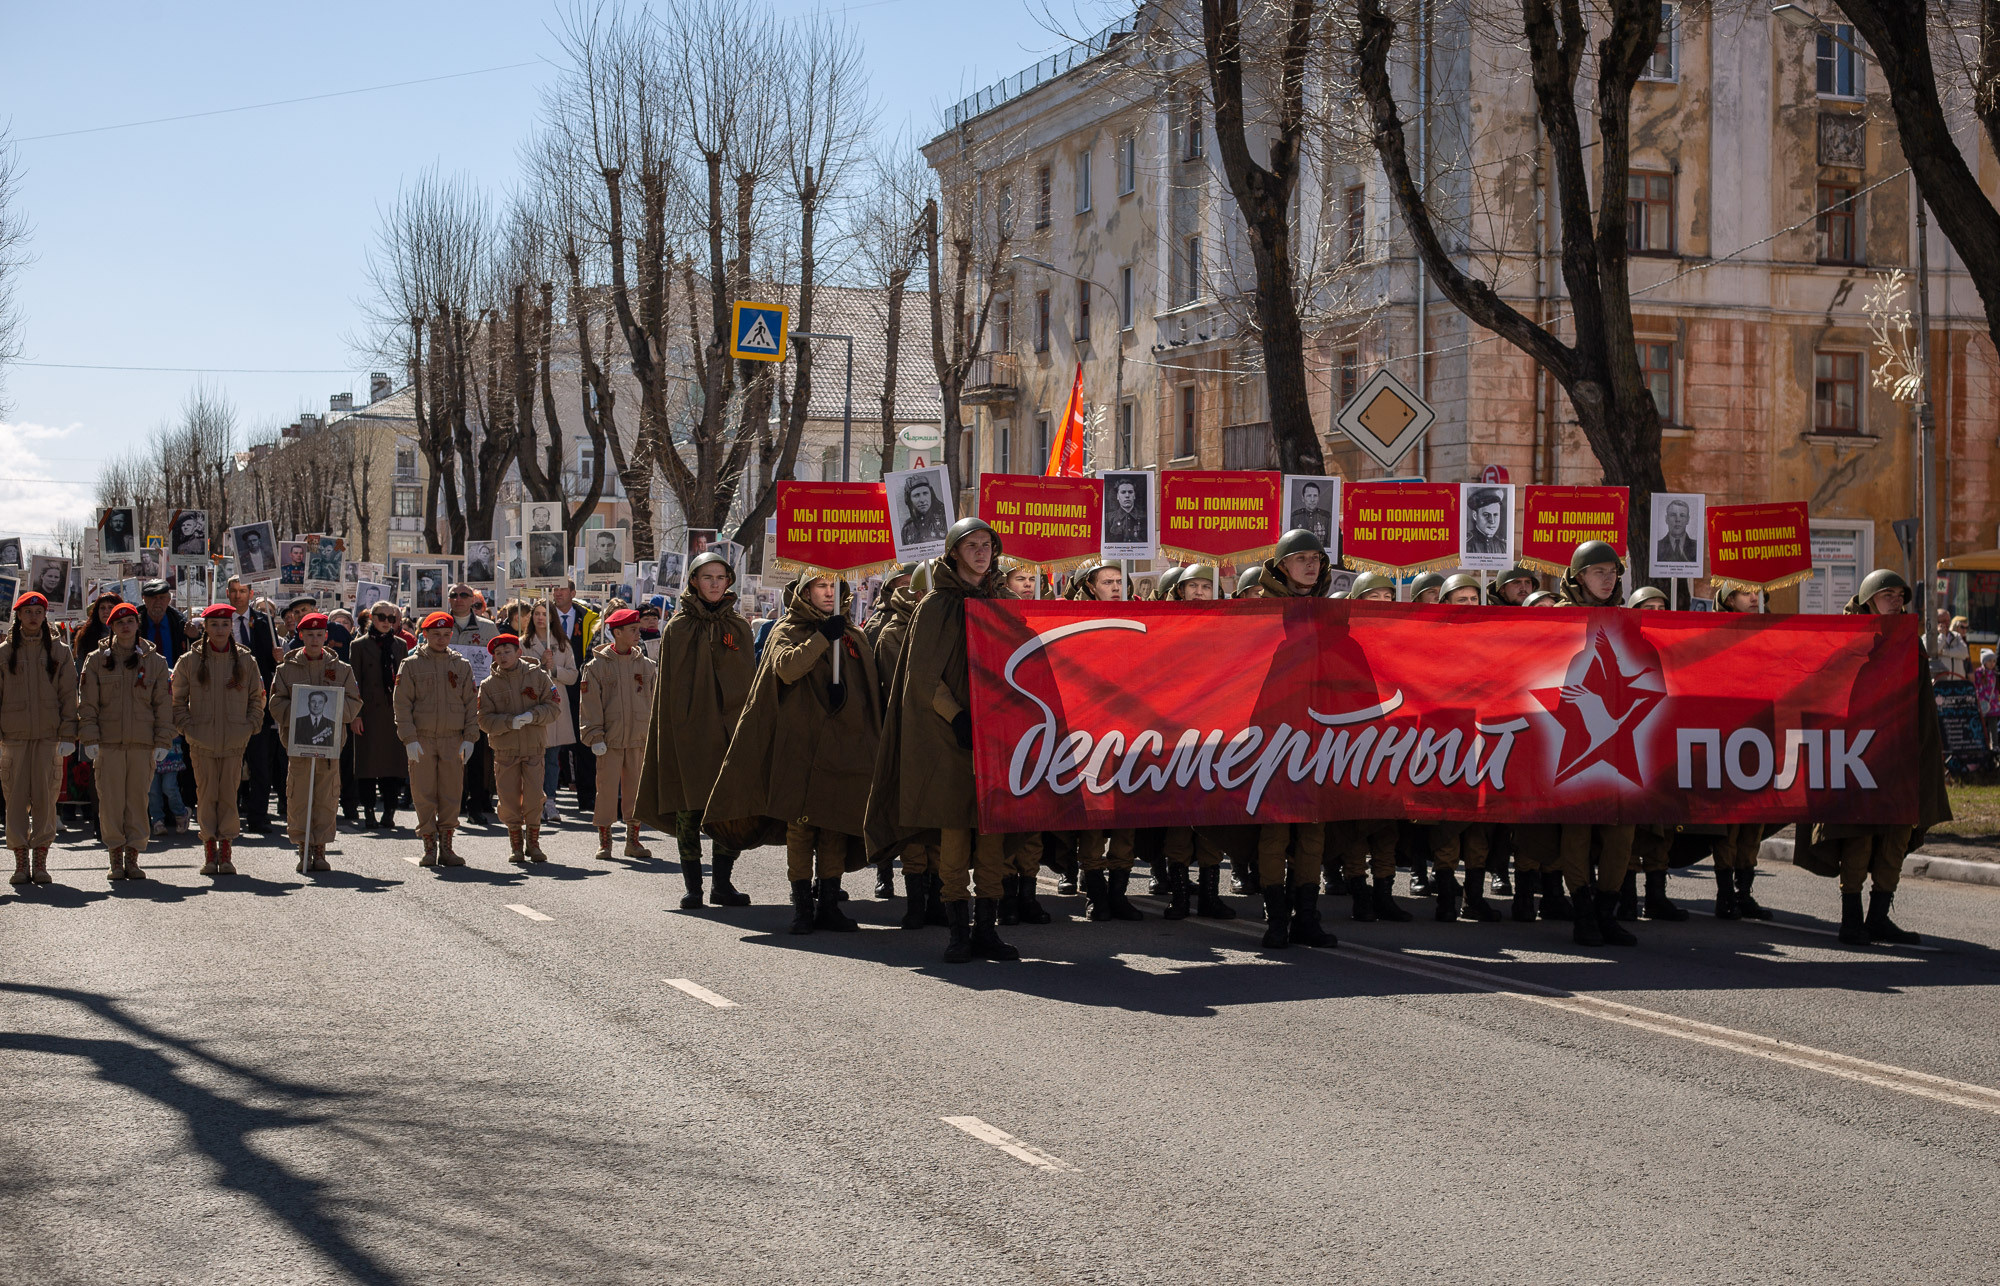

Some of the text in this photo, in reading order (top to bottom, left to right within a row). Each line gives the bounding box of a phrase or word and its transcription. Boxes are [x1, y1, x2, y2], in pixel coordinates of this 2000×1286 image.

[996, 500, 1087, 519] МЫ ПОМНИМ!
[1176, 496, 1264, 511] МЫ ПОМНИМ!
[793, 508, 885, 524] МЫ ПОМНИМ!
[1359, 508, 1445, 522] МЫ ПОМНИМ!
[1538, 511, 1615, 525] МЫ ПОМНИМ!
[990, 520, 1092, 538] МЫ ГОРДИМСЯ!
[1170, 516, 1269, 531] МЫ ГОРДИМСЯ!
[788, 528, 890, 545] МЫ ГОРДИМСЯ!
[1354, 527, 1450, 543] МЫ ГОРДИМСЯ!
[1533, 529, 1618, 544] МЫ ГОРДИМСЯ!
[1721, 526, 1796, 543] МЫ ПОМНИМ!
[1718, 543, 1802, 561] МЫ ГОРДИМСЯ!
[1676, 727, 1879, 791] ПОЛК
